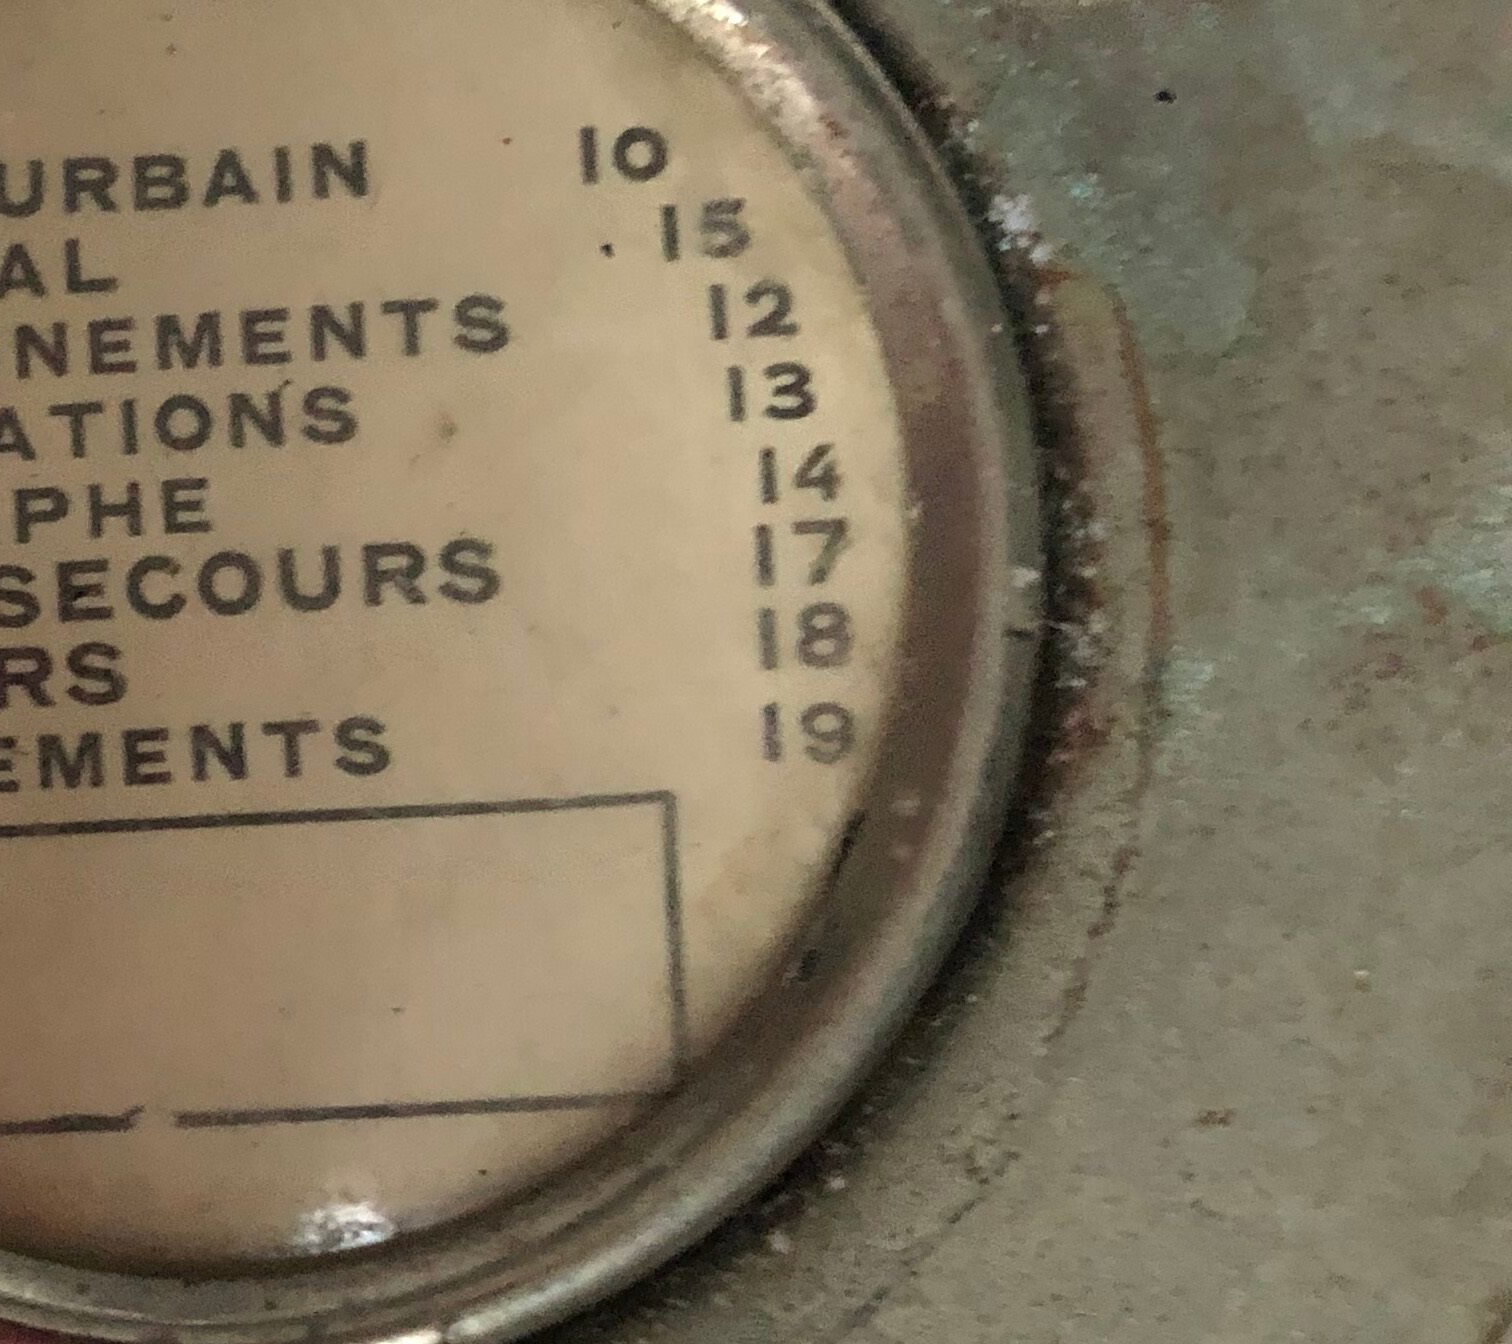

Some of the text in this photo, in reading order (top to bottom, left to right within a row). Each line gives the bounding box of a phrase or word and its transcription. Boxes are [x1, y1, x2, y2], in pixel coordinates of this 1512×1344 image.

[580, 126, 669, 185] 10
[661, 197, 752, 261] 15
[709, 280, 799, 340] 12
[728, 362, 817, 422] 13
[758, 443, 842, 505] 14
[755, 517, 851, 587] 17
[757, 601, 852, 670] 18
[763, 701, 855, 764] 19
